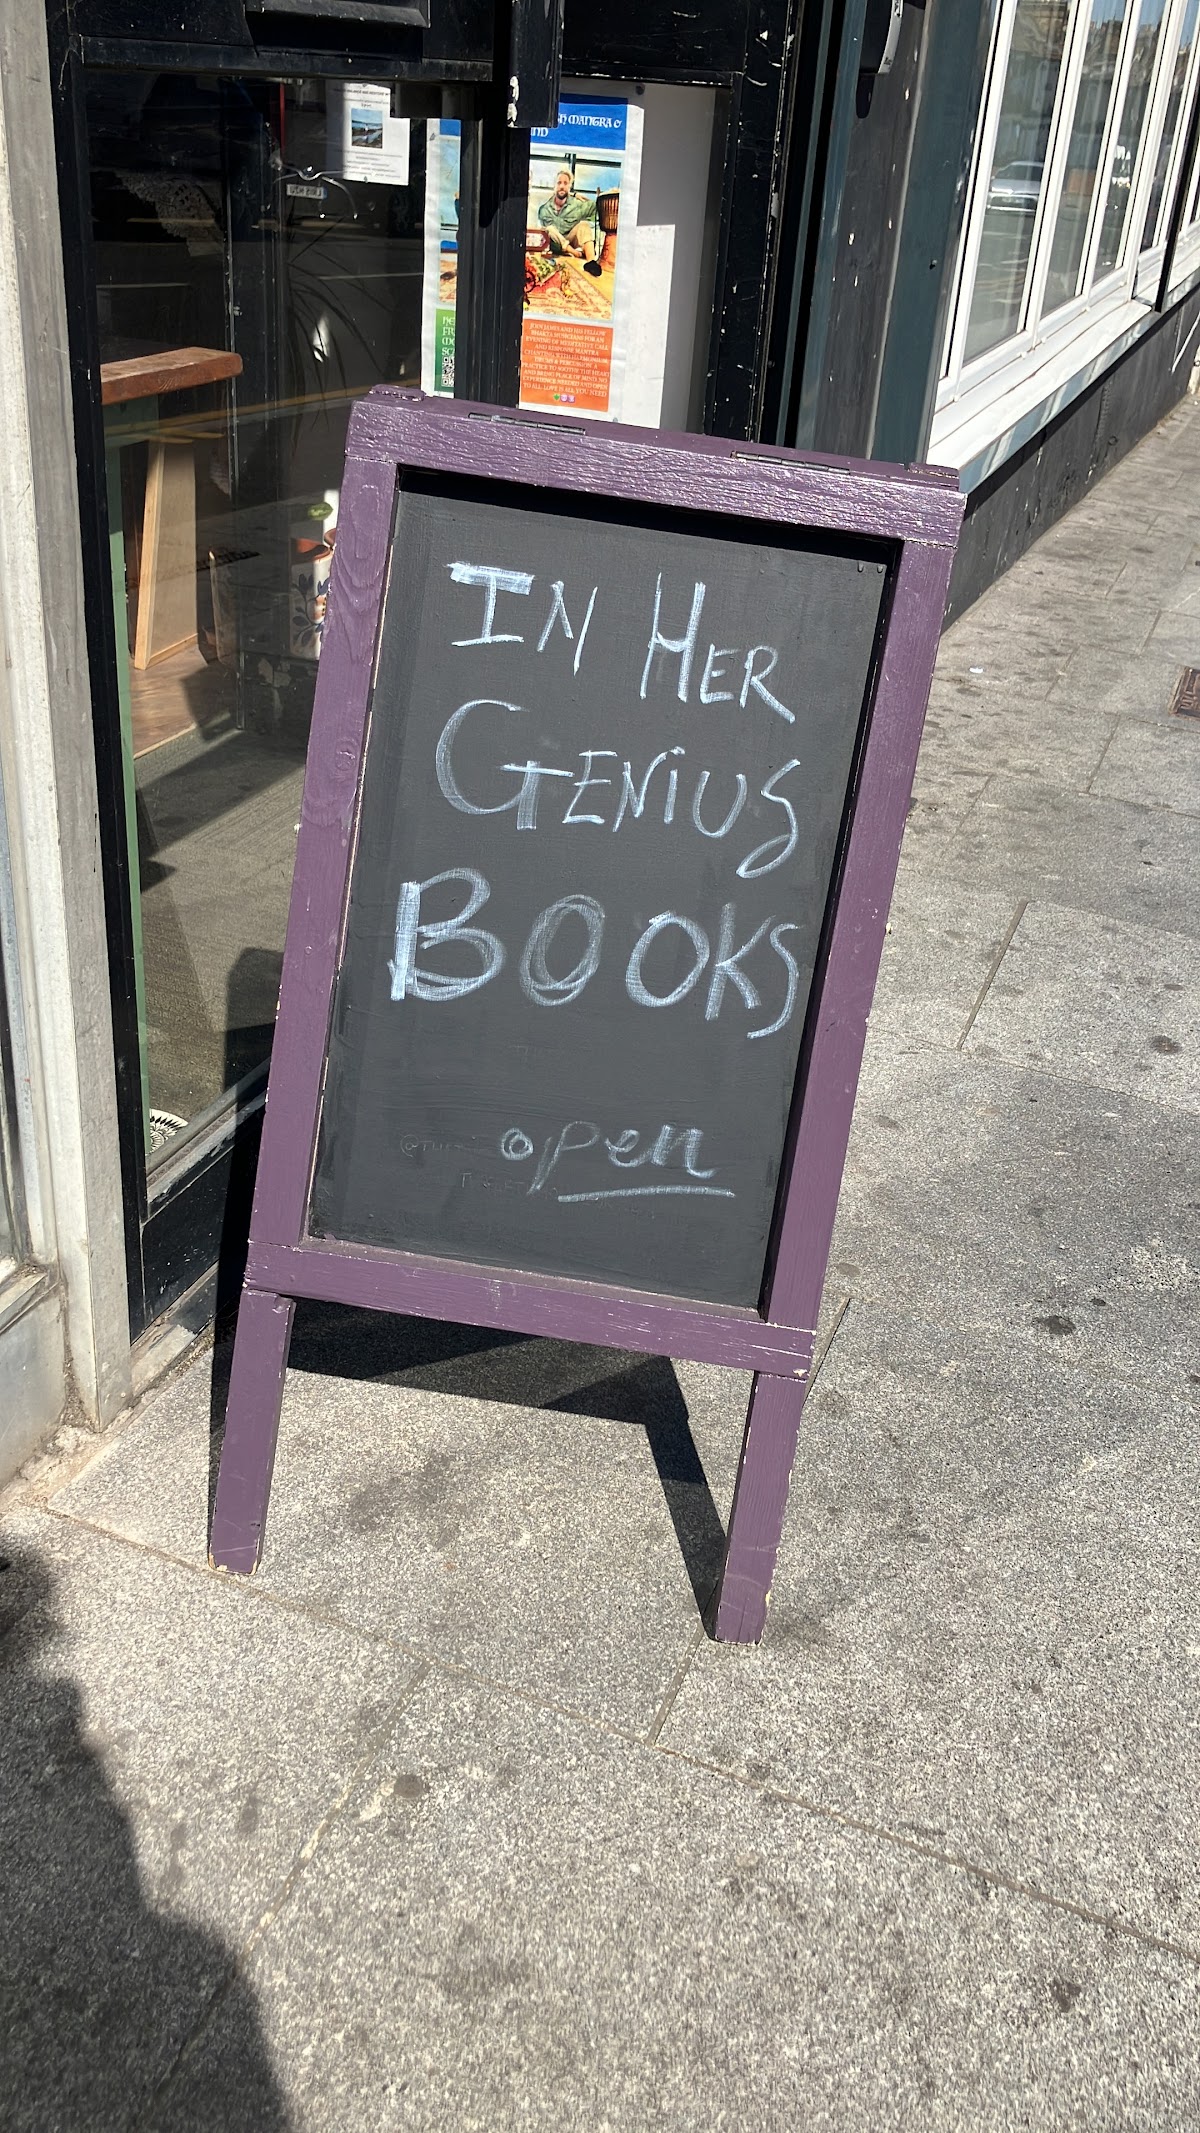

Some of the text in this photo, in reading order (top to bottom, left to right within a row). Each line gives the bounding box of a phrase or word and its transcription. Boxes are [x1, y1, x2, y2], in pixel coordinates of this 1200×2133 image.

[568, 114, 612, 129] MANTRA
[442, 316, 456, 326] HE
[442, 326, 456, 336] FR
[441, 337, 455, 346] MO
[560, 339, 593, 348] MEDITATIVE
[595, 342, 608, 350] CALL
[576, 348, 598, 356] MANTRA
[592, 369, 609, 377] HEART
[593, 382, 608, 390] OPEN
[446, 561, 796, 724] IN HER
[435, 700, 801, 879] GENIUS
[387, 868, 800, 1040] BOOKS
[502, 1120, 718, 1197] open
